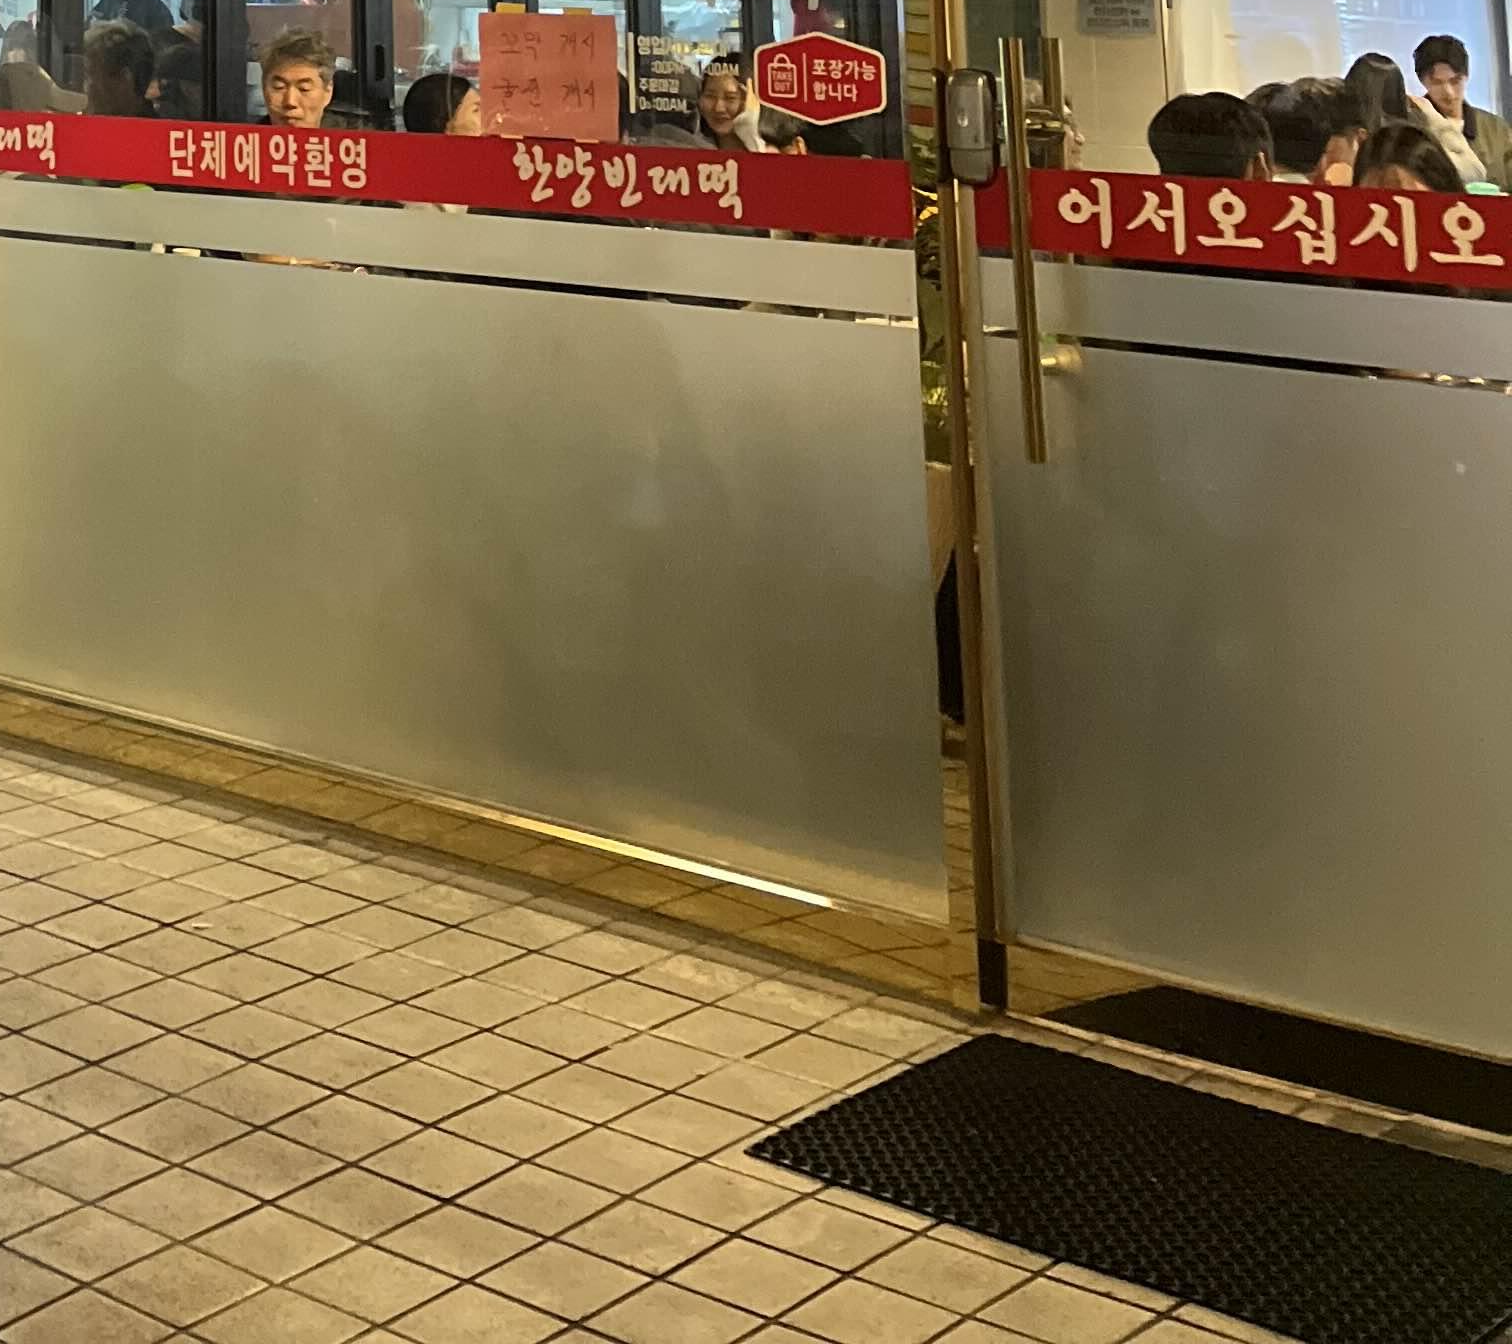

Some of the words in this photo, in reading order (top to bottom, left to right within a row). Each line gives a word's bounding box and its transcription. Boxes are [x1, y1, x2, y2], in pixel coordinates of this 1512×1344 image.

[772, 70, 793, 82] TAKE
[811, 58, 877, 82] 포장가능
[773, 81, 791, 92] OUT
[812, 80, 858, 103] 합니다
[168, 128, 369, 191] 단체예약환영
[1057, 177, 1504, 274] 어서오십시오
